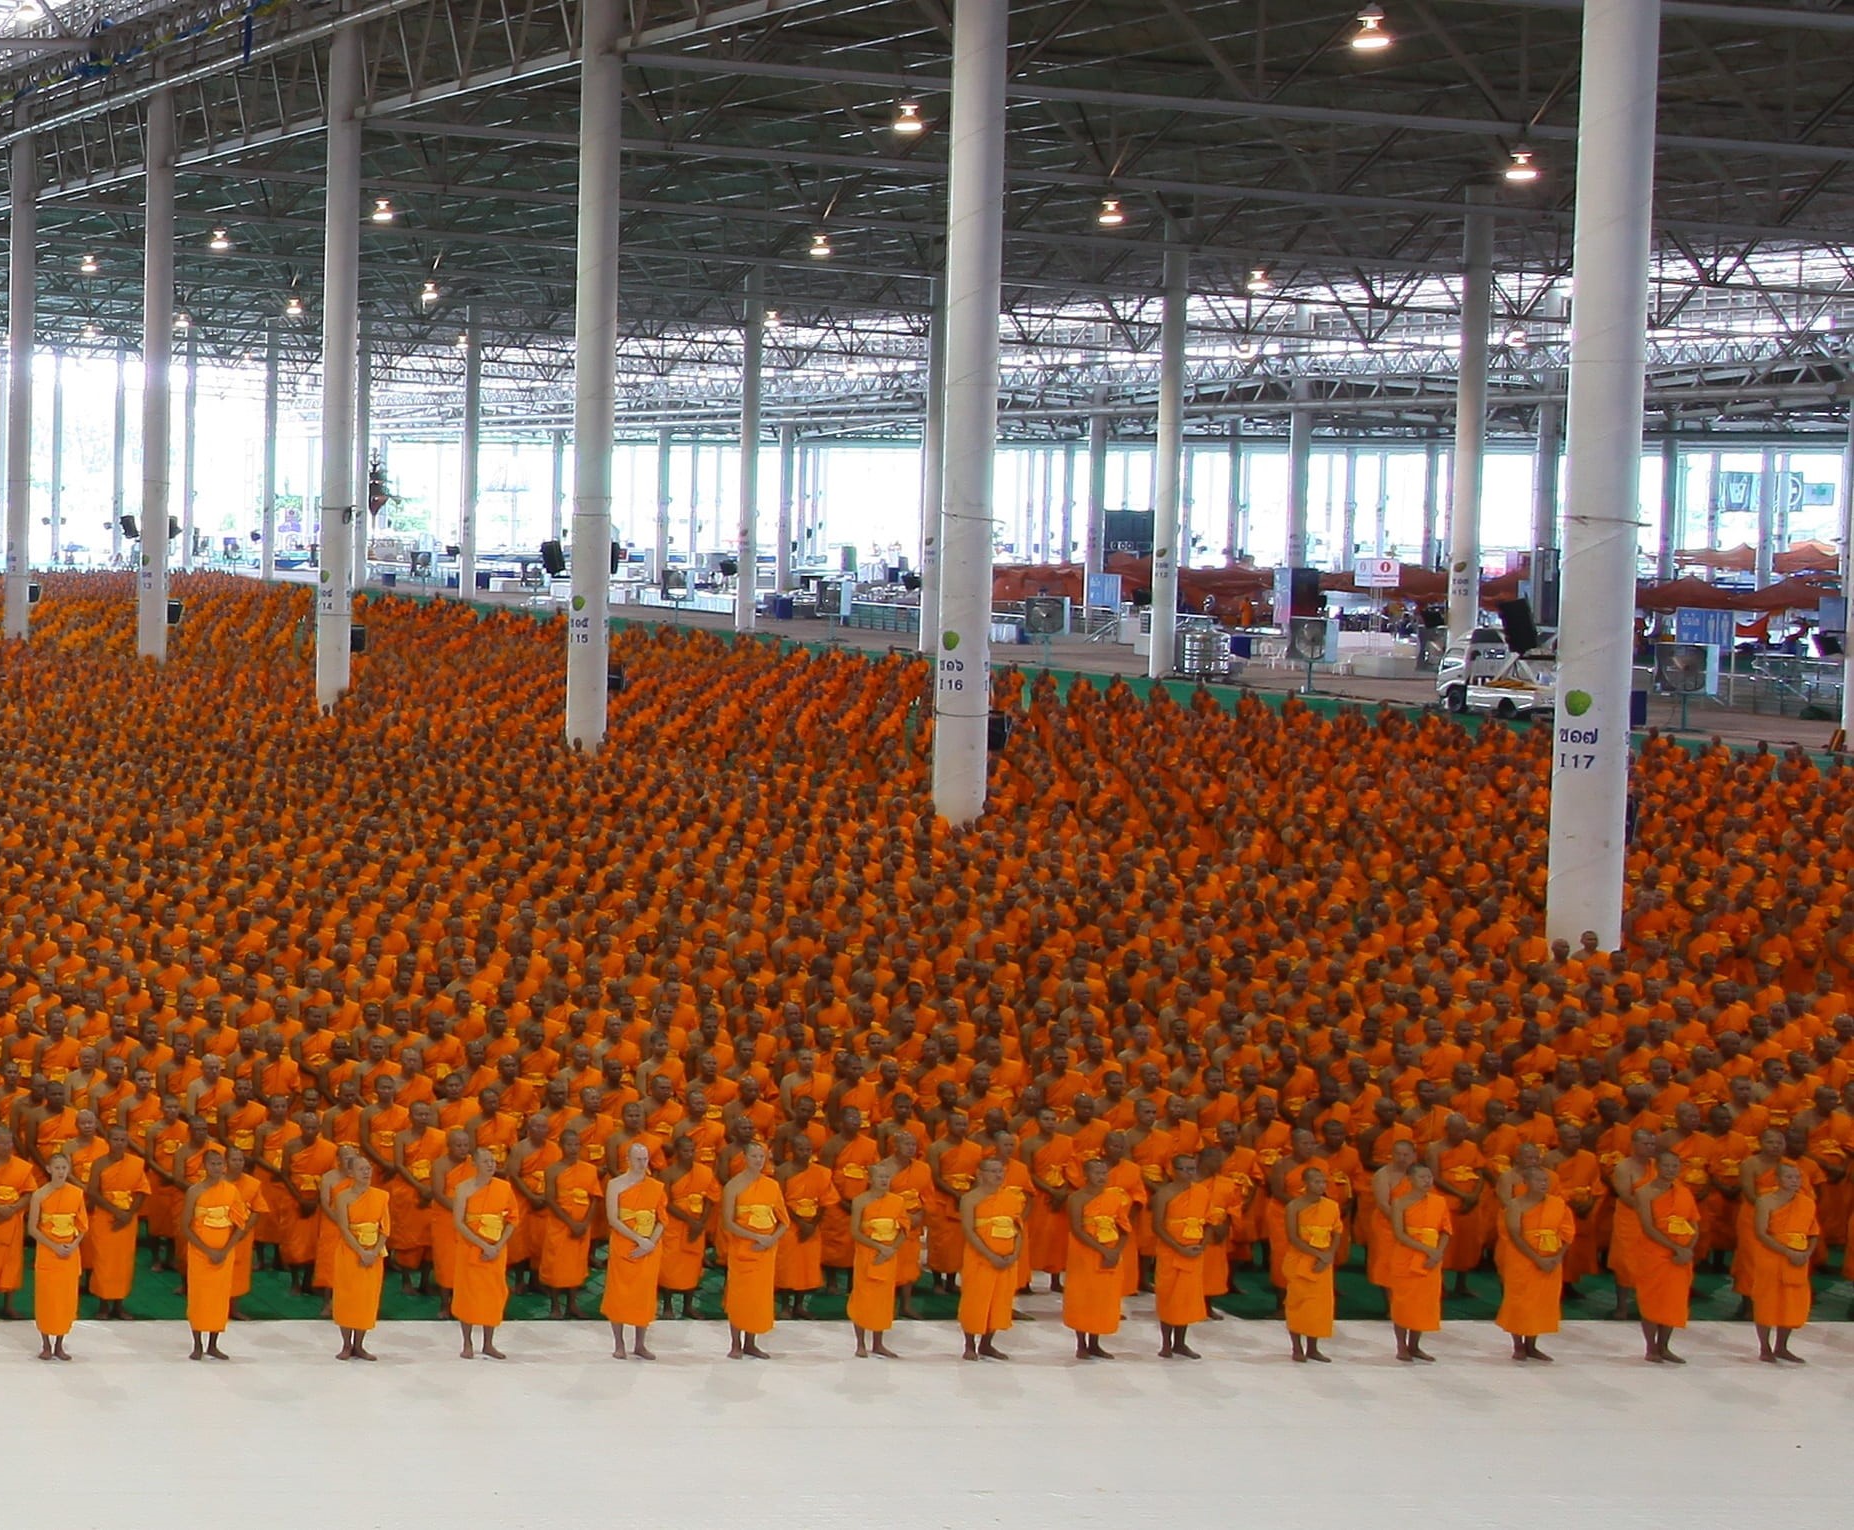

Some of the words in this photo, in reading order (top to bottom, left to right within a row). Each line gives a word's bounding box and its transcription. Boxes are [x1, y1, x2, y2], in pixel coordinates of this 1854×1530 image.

[576, 633, 589, 643] 15
[948, 679, 963, 691] 16
[1560, 752, 1566, 768] I
[1571, 753, 1596, 769] 17
